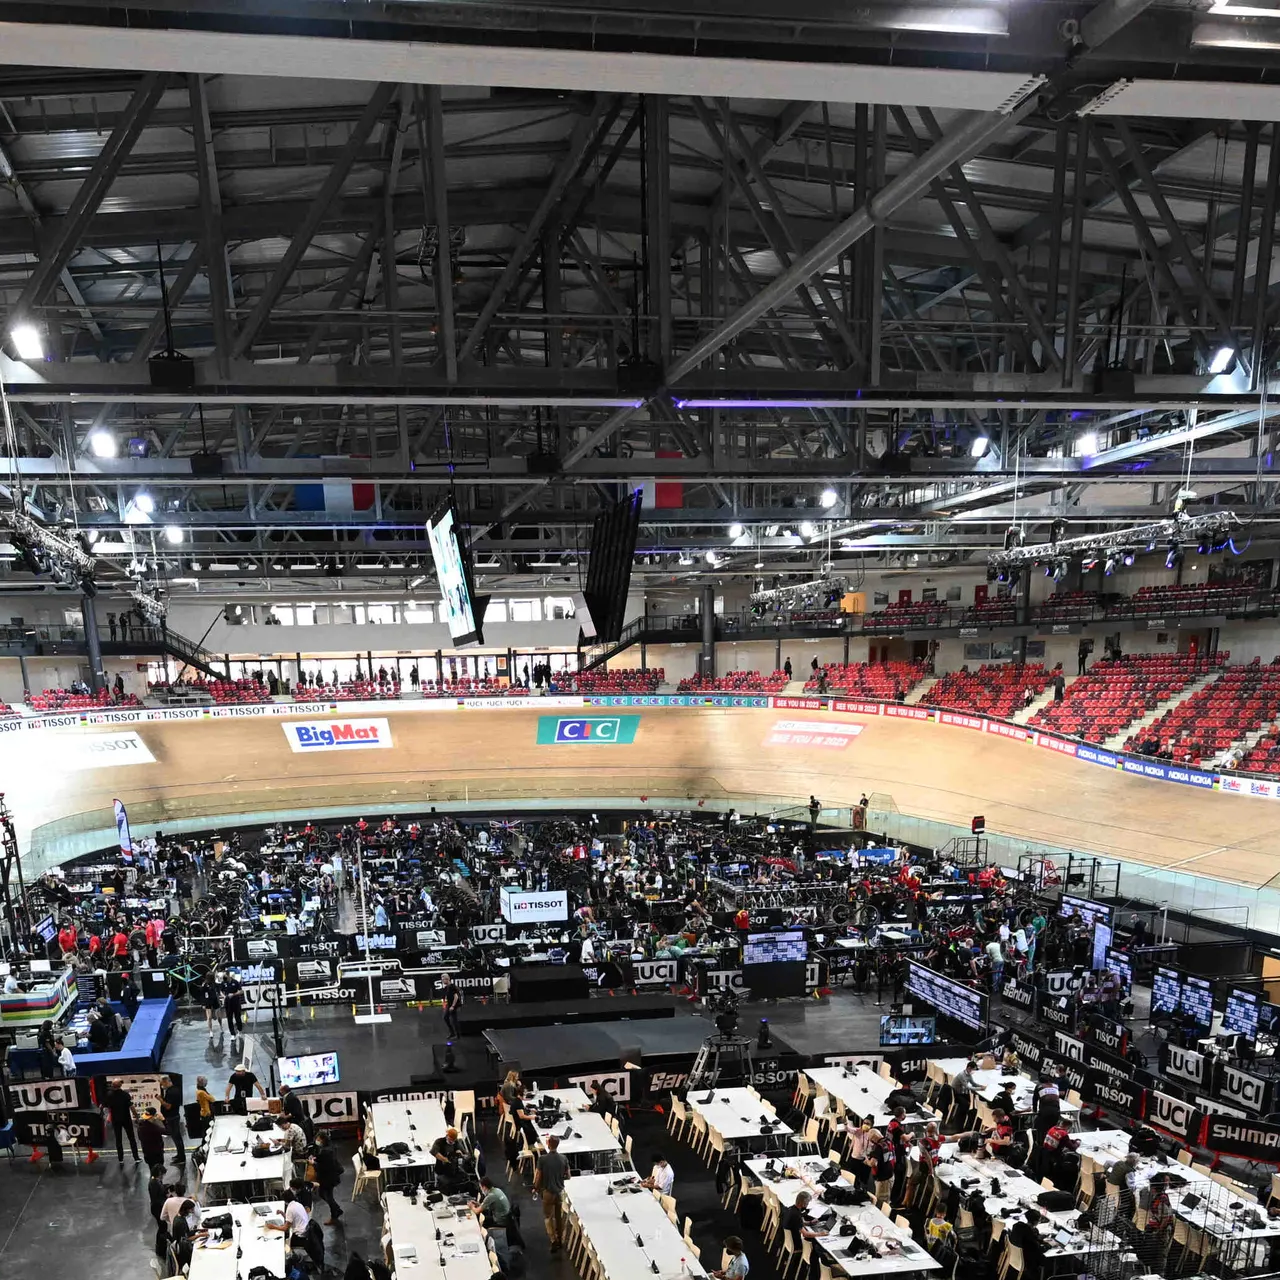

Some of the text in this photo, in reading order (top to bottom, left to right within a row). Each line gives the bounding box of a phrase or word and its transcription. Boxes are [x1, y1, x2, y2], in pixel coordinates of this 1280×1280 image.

[235, 706, 266, 715] TISSOT
[295, 704, 326, 713] TISSOT
[788, 700, 799, 708] YOU
[836, 702, 846, 710] SEE
[847, 703, 858, 711] YOU
[104, 712, 141, 723] TISSOT
[163, 709, 199, 720] TISSOT
[898, 708, 908, 716] YOU
[42, 716, 77, 729] TISSOT
[295, 724, 379, 746] BigMat
[563, 722, 614, 738] CIC
[1078, 748, 1097, 762] NOKIA
[1097, 753, 1116, 767] NOKIA
[1124, 761, 1144, 773] NOKIA
[1144, 765, 1165, 777] NOKIA
[1168, 769, 1189, 782] NOKIA
[1190, 774, 1212, 786] NOKIA
[1223, 778, 1242, 791] BigMat
[1250, 782, 1270, 795] BigMat
[527, 900, 564, 909] TISSOT
[399, 920, 434, 929] TISSOT
[356, 933, 397, 950] BigMat
[474, 928, 505, 942] UCI
[300, 941, 339, 953] TISSOT
[641, 964, 674, 979] UCI
[312, 988, 357, 999] TISSOT
[1003, 984, 1032, 1006] Santini
[1042, 1007, 1070, 1025] TISSOT
[1095, 1028, 1120, 1048] TISSOT
[1172, 1051, 1200, 1078] UCI
[1094, 1082, 1133, 1108] TISSOT
[1227, 1073, 1260, 1104] UCI
[22, 1085, 71, 1107] UCI
[302, 1097, 352, 1118] UCI
[1160, 1096, 1190, 1128] UCI
